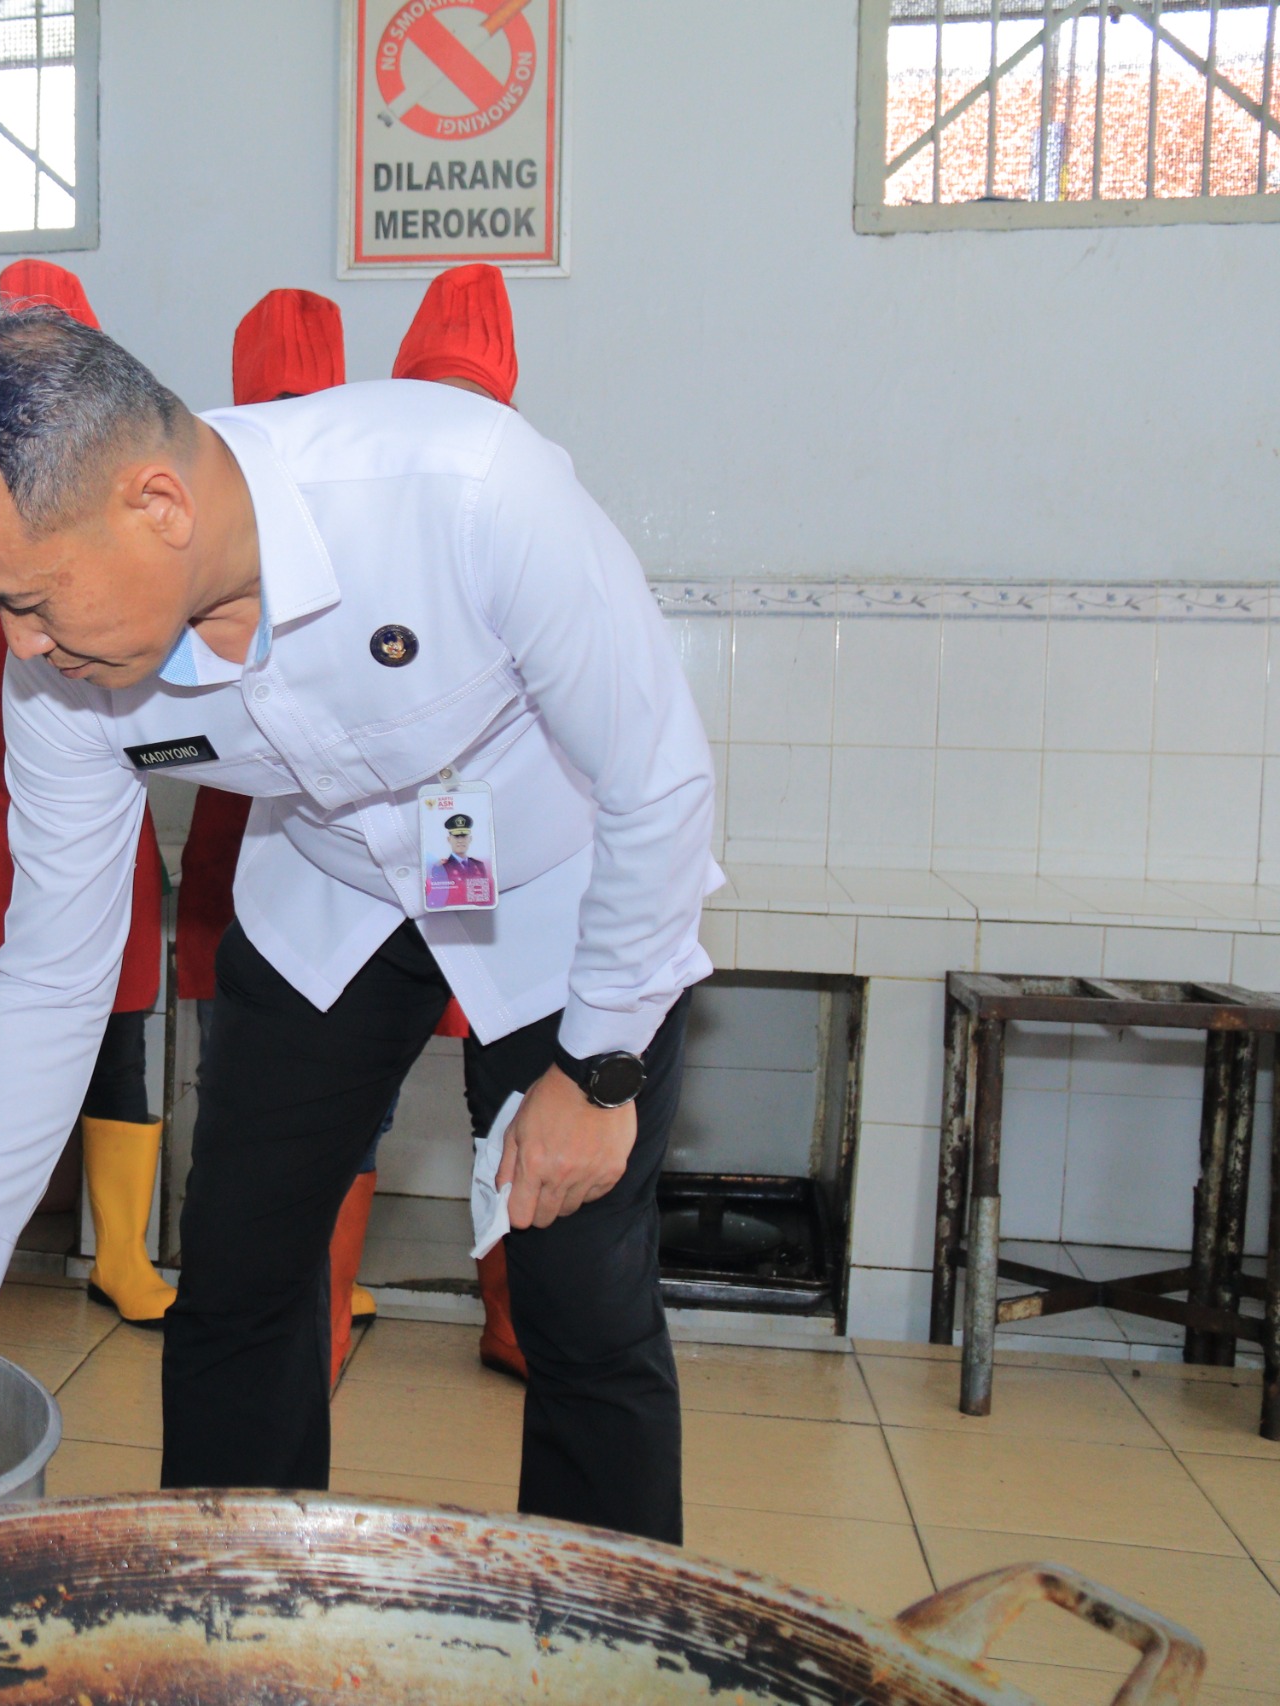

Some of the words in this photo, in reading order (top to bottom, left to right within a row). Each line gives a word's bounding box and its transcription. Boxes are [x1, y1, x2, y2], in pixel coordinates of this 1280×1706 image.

[381, 42, 398, 71] NO
[516, 52, 533, 81] NO
[436, 83, 524, 135] SMOKING!
[373, 158, 538, 192] DILARANG
[374, 207, 536, 240] MEROKOK
[139, 745, 199, 765] KADIYONO
